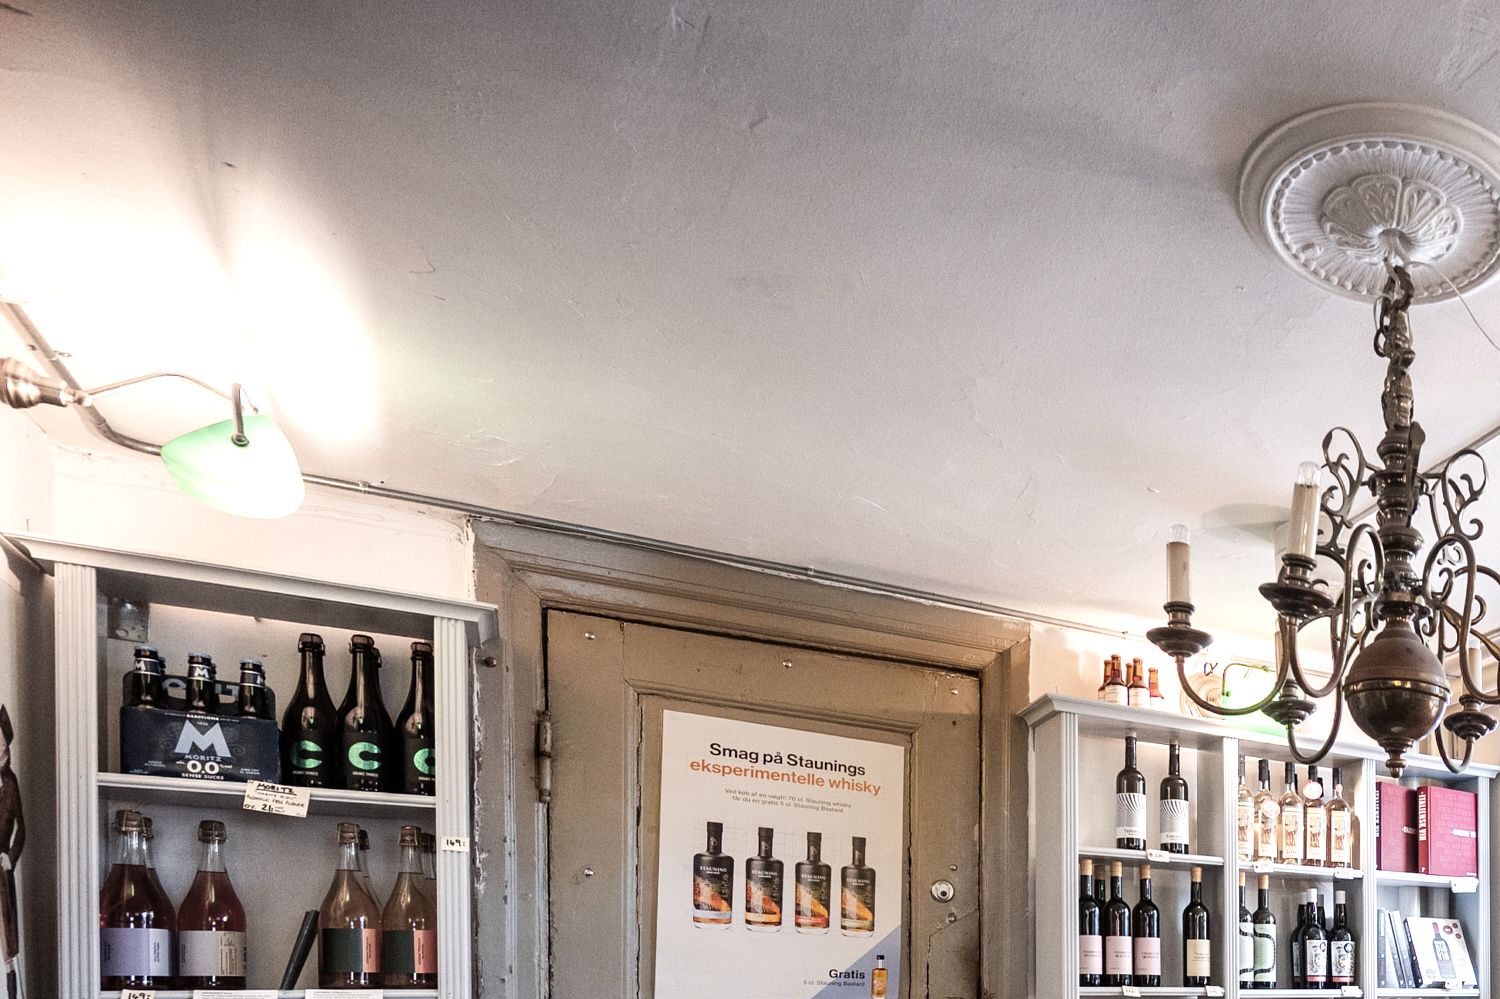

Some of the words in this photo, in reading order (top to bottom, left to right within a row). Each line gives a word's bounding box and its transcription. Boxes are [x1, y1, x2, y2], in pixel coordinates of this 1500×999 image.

[174, 720, 232, 757] M
[185, 754, 222, 762] MORITZ
[186, 760, 220, 775] 0.0
[348, 741, 382, 771] C
[709, 742, 759, 764] Smag
[763, 751, 783, 765] på
[786, 753, 866, 777] Staunings
[690, 759, 825, 787] eksperimentelle
[828, 777, 881, 797] whisky
[1418, 794, 1427, 828] ITALIENSK
[828, 969, 866, 980] Gratis
